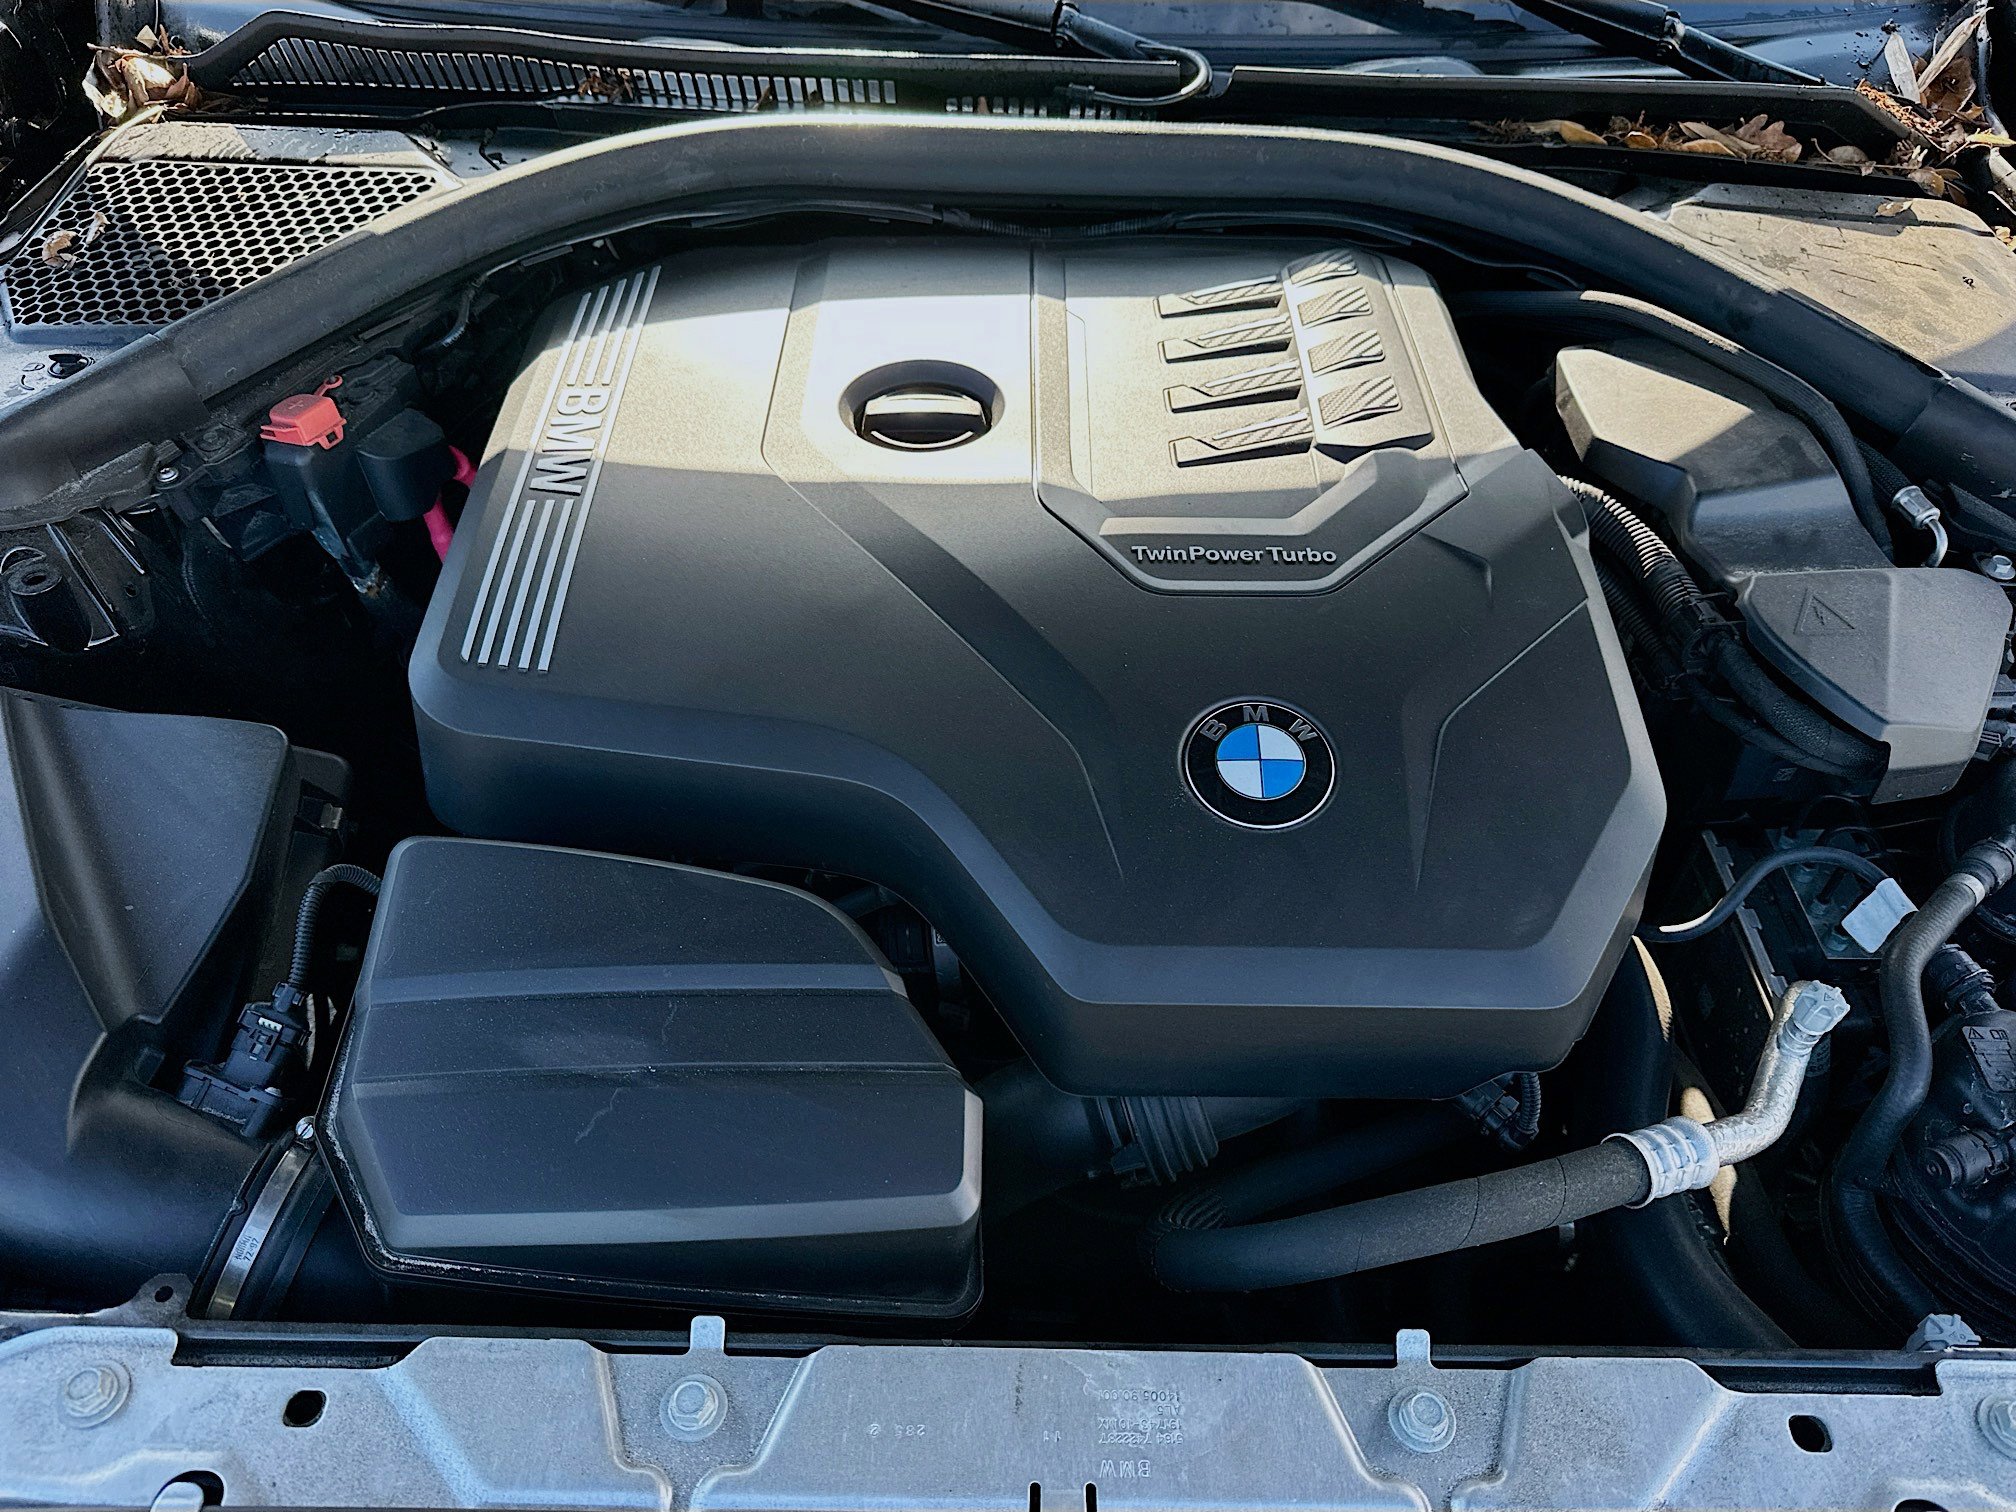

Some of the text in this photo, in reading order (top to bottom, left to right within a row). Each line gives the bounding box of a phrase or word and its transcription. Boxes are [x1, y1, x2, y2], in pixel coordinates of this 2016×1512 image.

[529, 388, 612, 496] BMW
[1131, 545, 1338, 563] TwinPower Turbo
[1200, 705, 1318, 742] BMW
[1098, 1459, 1151, 1479] BMW
